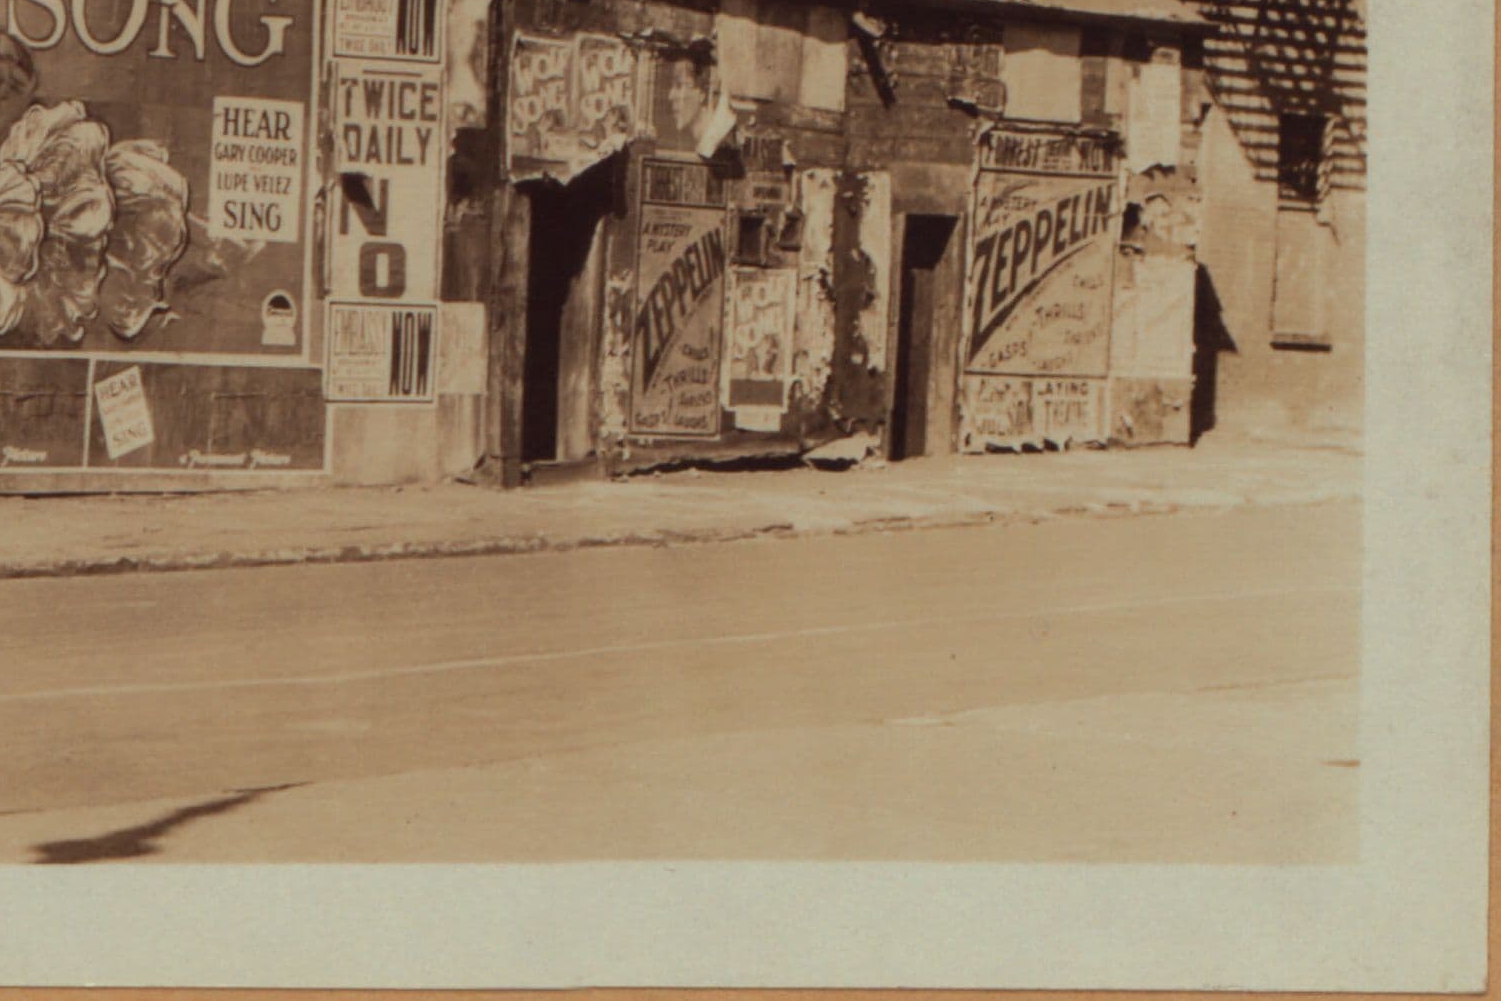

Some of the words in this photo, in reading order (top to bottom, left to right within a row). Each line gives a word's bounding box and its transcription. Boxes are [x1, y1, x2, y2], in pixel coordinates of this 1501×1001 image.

[340, 78, 438, 121] TWICE
[222, 106, 291, 141] HEAR
[214, 142, 246, 163] GARY
[247, 145, 298, 168] COOPER
[342, 125, 434, 166] DAILY
[217, 171, 248, 193] LUPE
[253, 173, 293, 197] VELEZ
[223, 200, 283, 234] SING
[970, 181, 1114, 361] ZEPPELIN
[635, 227, 725, 395] ZEPPELIN
[389, 311, 432, 396] NOW
